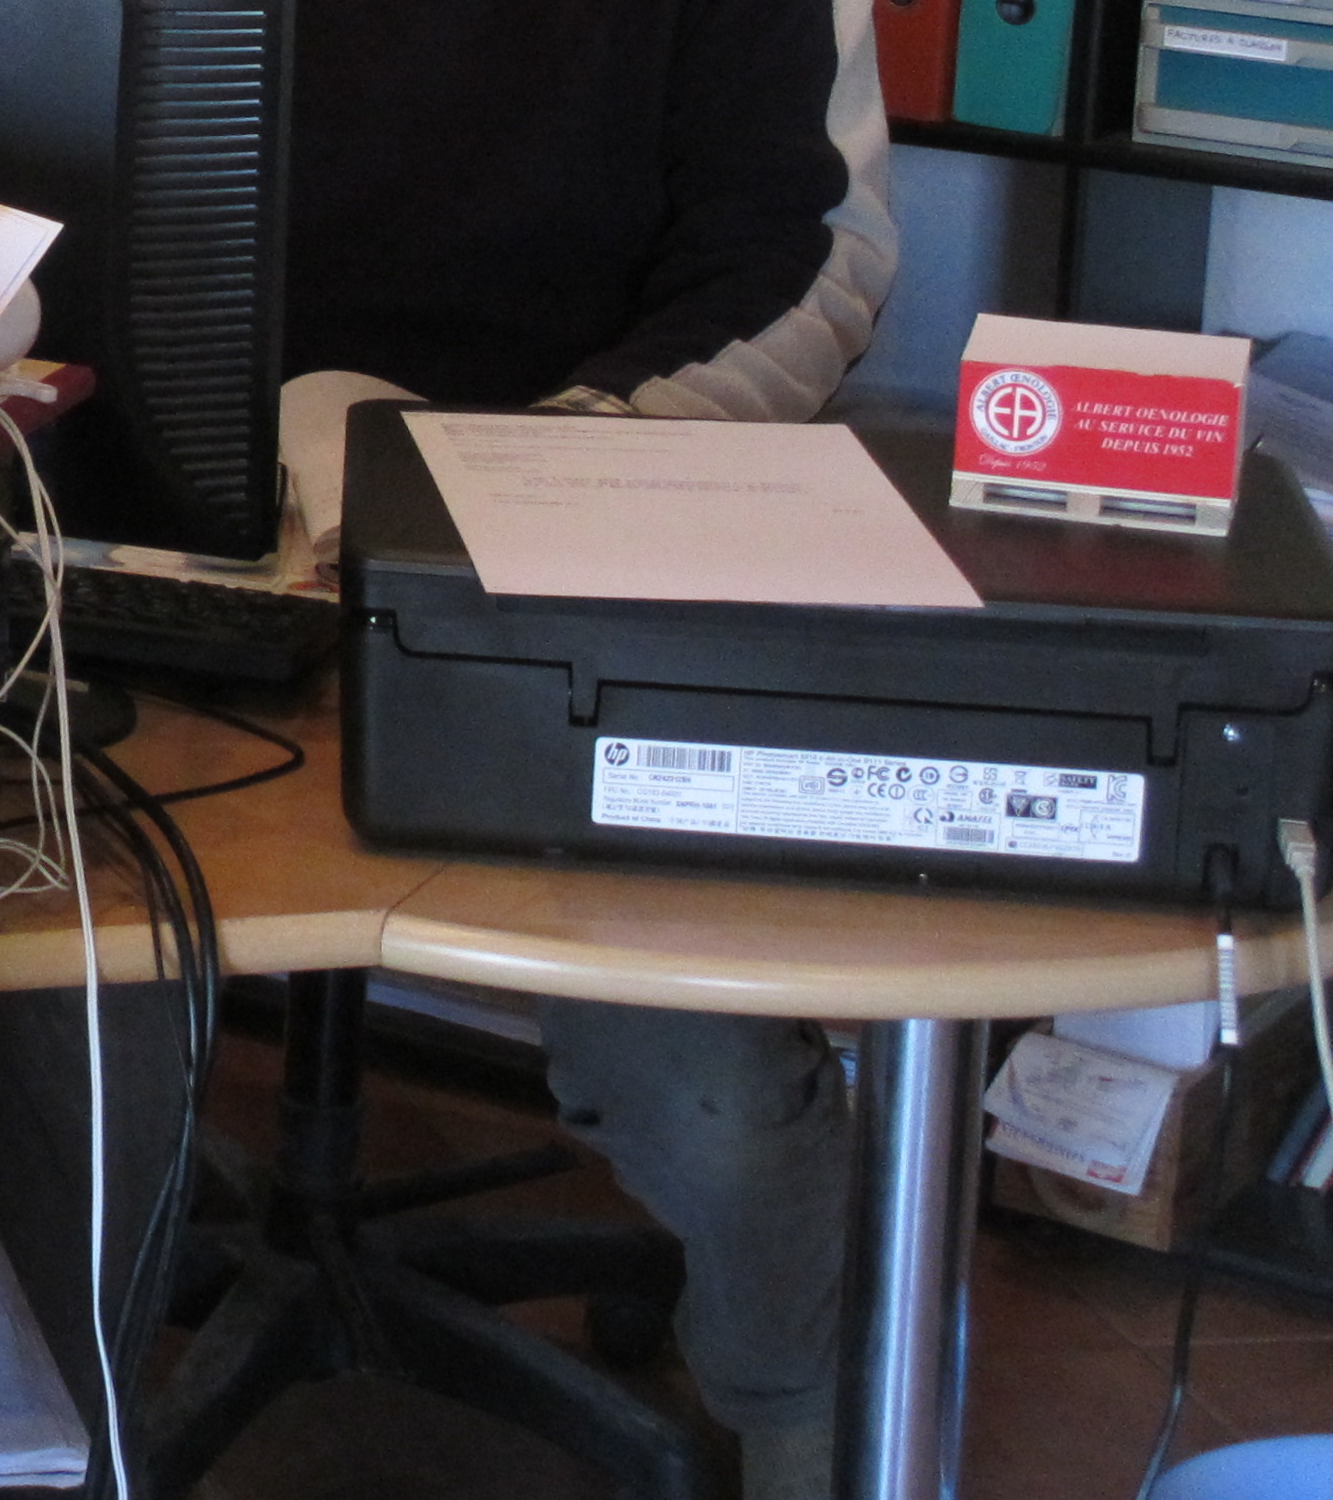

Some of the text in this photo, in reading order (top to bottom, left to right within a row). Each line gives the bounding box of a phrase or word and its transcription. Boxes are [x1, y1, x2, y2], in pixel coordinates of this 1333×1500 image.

[1073, 400, 1231, 428] ALBERT OENOLOGIE
[1074, 418, 1226, 444] AU SERVICE DU VIN
[1100, 437, 1196, 458] DEPUIS 1952
[604, 741, 630, 767] hp
